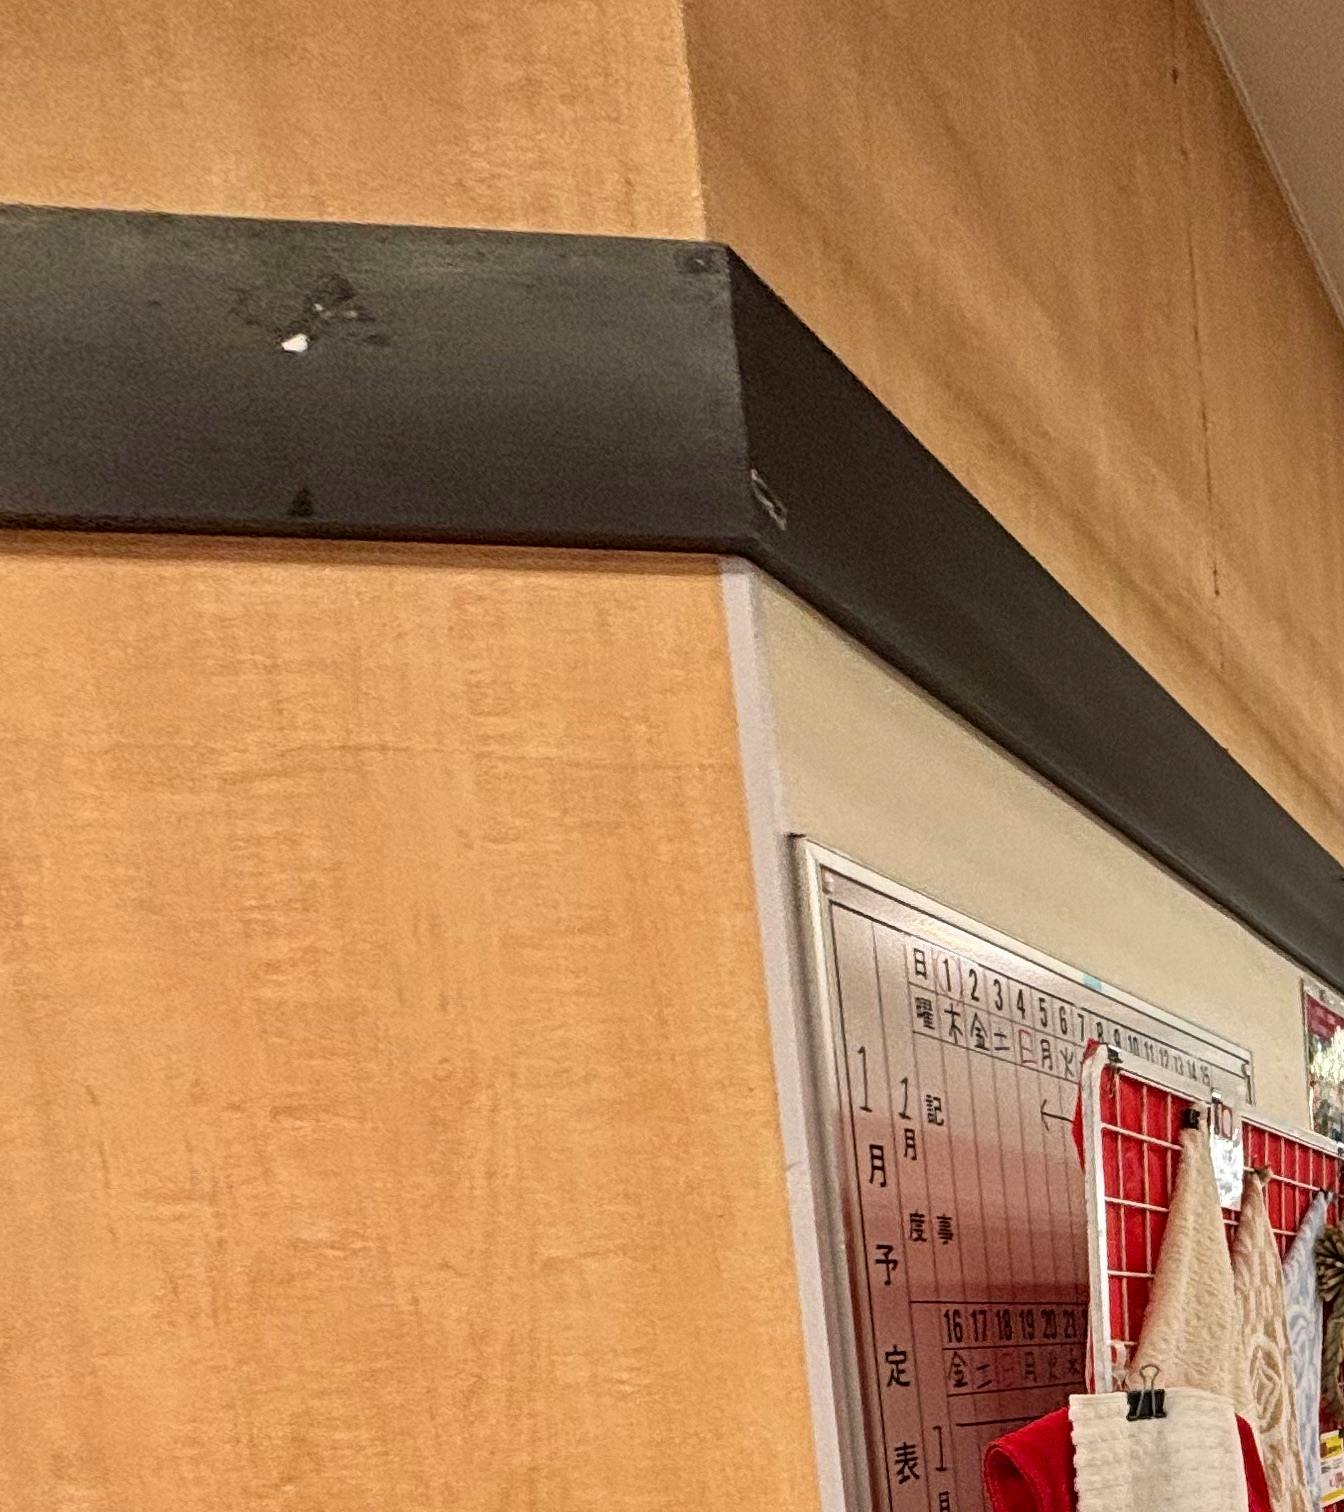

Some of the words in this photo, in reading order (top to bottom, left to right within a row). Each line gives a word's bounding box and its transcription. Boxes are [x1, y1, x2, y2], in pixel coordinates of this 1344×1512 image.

[913, 948, 928, 979] 日
[969, 968, 980, 1002] 2
[993, 978, 1004, 1011] 3
[1016, 989, 1026, 1020] 4
[1039, 997, 1048, 1028] 5
[1058, 1005, 1068, 1036] 6
[1077, 1013, 1085, 1043] 7
[1095, 1021, 1105, 1044] 8
[1127, 1034, 1140, 1058] 10
[1143, 1041, 1156, 1065] 11
[1158, 1047, 1170, 1069] 12
[1173, 1054, 1185, 1077] 13
[1186, 1059, 1198, 1082] 14
[943, 1003, 963, 1045] 木
[969, 1012, 989, 1052] 金
[1040, 1037, 1053, 1071] 月
[1058, 1046, 1075, 1083] 火
[943, 1308, 964, 1344] 16
[970, 1308, 988, 1343] 17
[995, 1308, 1013, 1342] 18
[1018, 1308, 1036, 1342] 19
[1040, 1308, 1058, 1340] 20
[1062, 1308, 1078, 1339] 21
[947, 1350, 969, 1389] 金
